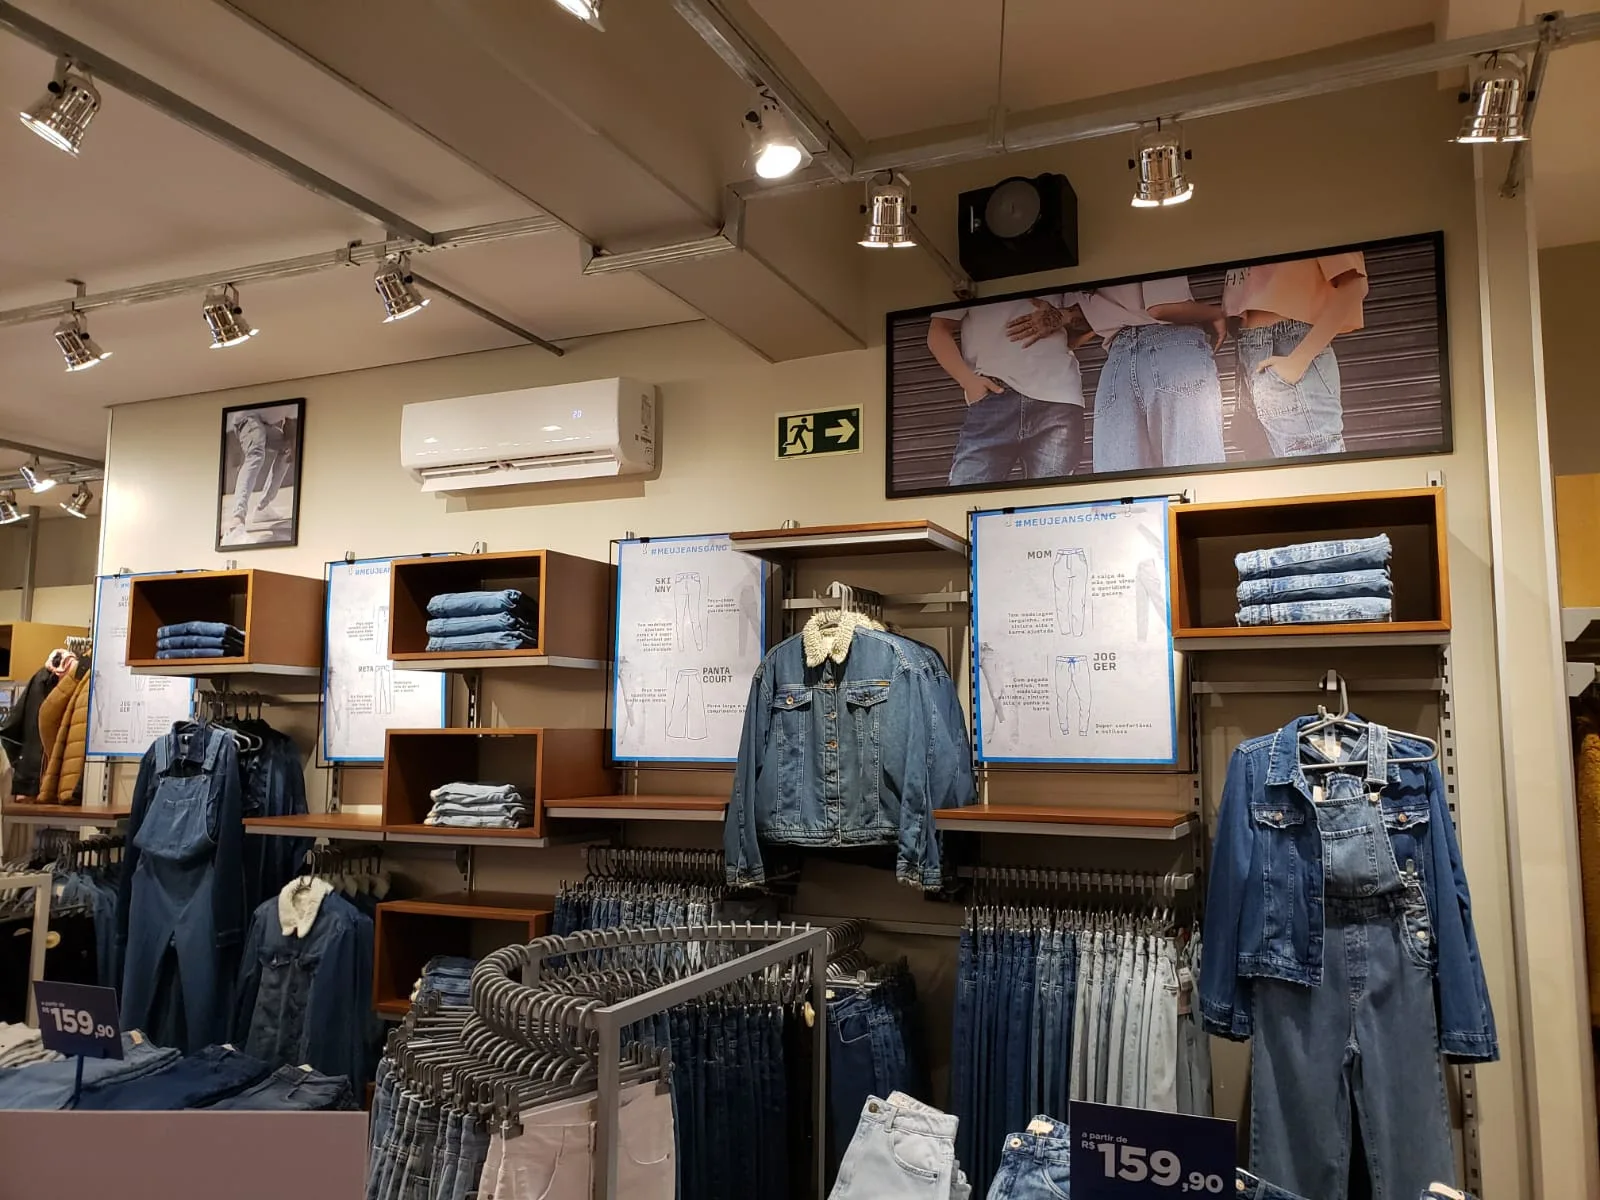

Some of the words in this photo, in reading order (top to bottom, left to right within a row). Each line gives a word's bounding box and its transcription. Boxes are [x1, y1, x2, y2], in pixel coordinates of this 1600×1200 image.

[1015, 512, 1117, 528] #MEUJEANSGANG
[651, 544, 728, 556] #MEUJEANSGANG
[1028, 550, 1052, 560] MOM
[656, 577, 671, 585] SKI
[1093, 653, 1116, 661] JOG
[358, 665, 374, 673] RETA
[703, 667, 731, 675] PANTA
[1094, 663, 1117, 671] GER
[703, 675, 733, 683] COURT
[1089, 1132, 1114, 1143] partir
[1115, 1135, 1128, 1144] de
[1081, 1140, 1095, 1150] R$
